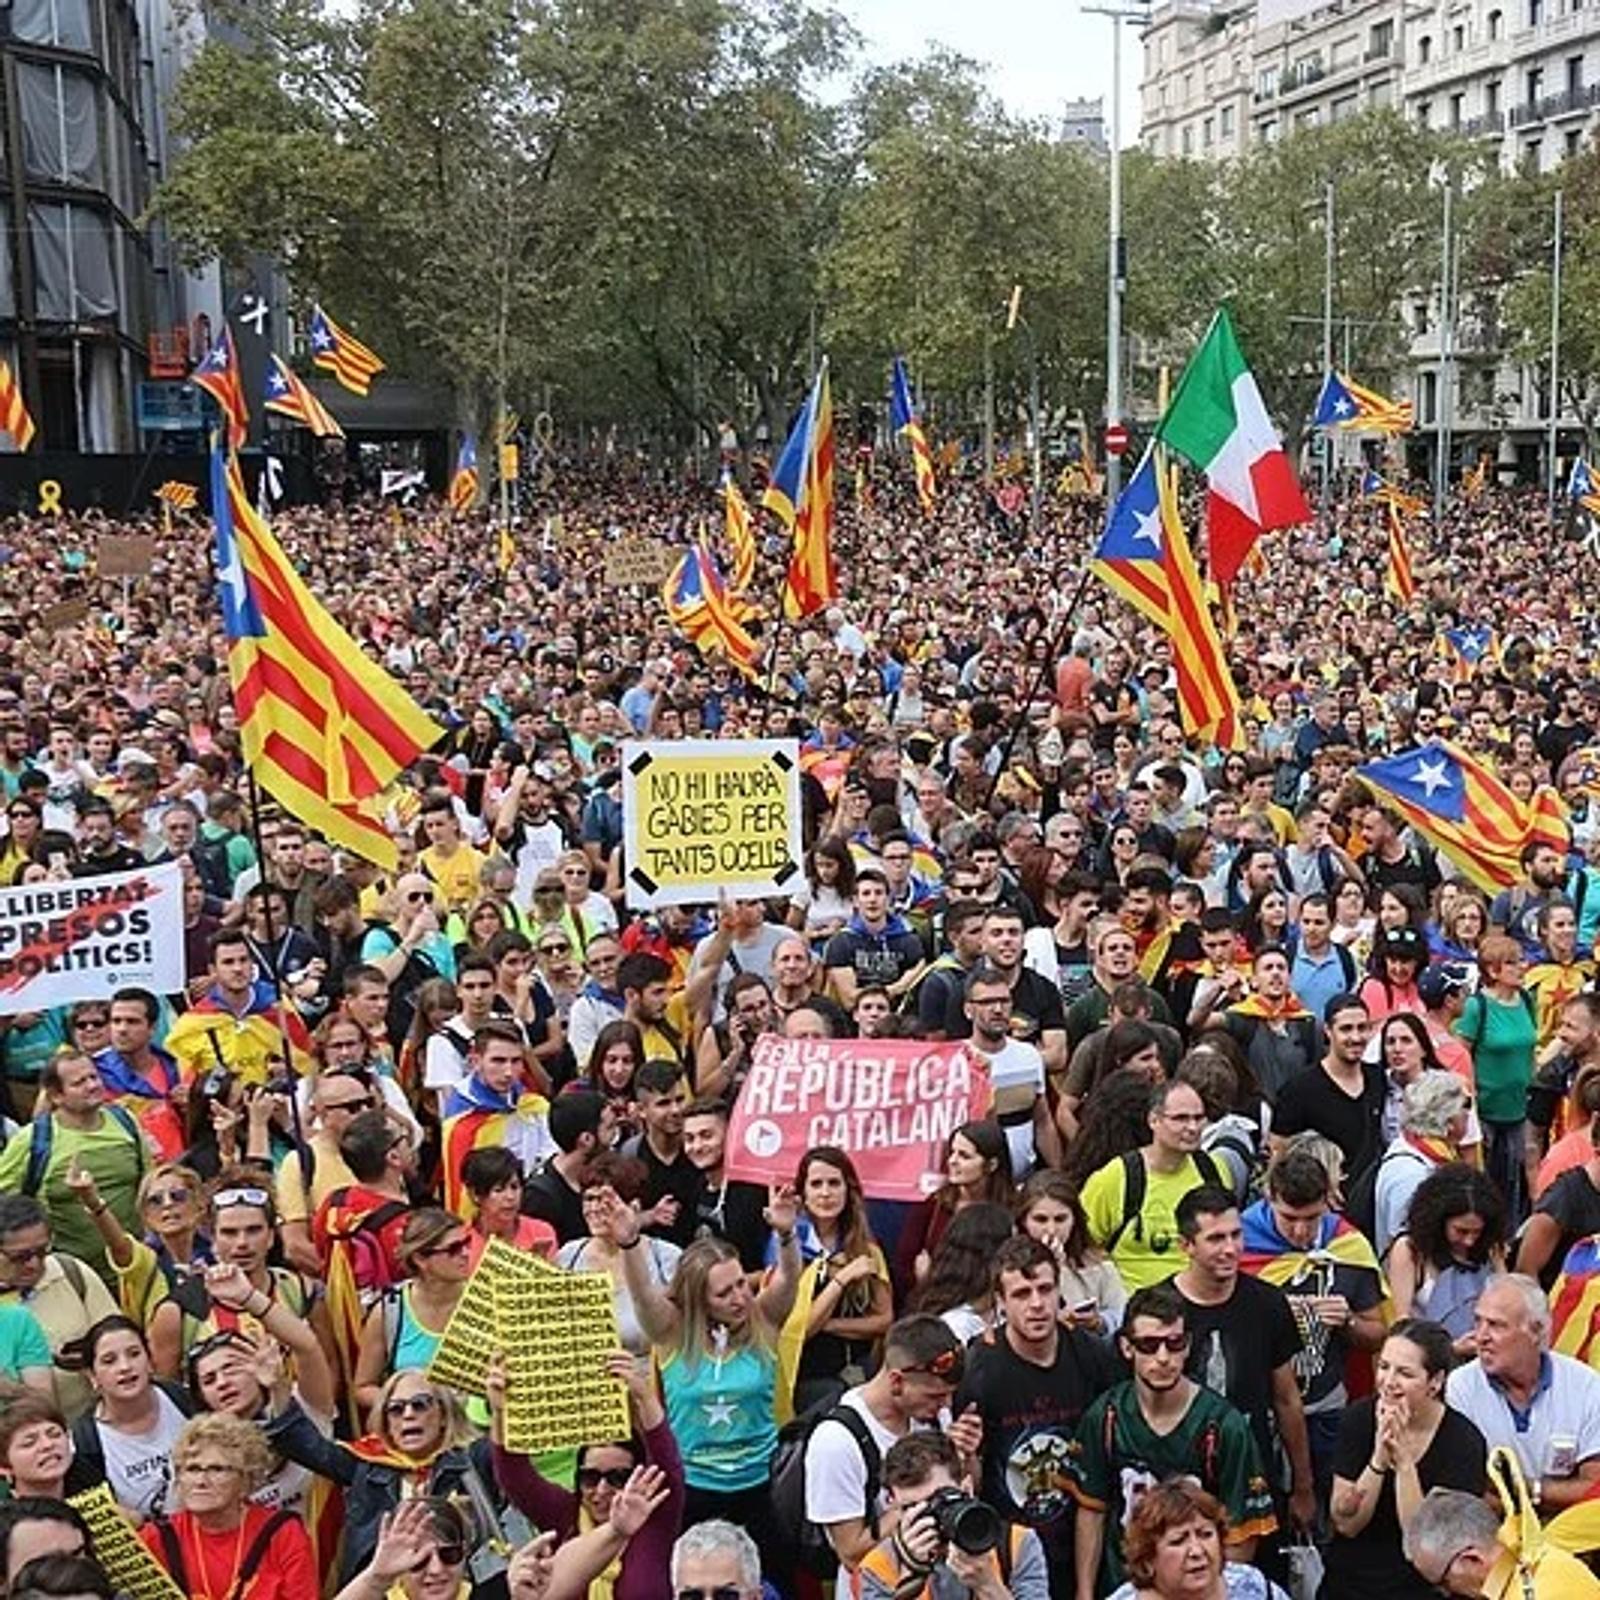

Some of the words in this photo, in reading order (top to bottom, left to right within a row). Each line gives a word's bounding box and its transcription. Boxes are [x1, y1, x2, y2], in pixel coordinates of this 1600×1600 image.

[651, 771, 680, 801] NO
[686, 772, 706, 799] HI
[648, 801, 731, 839] GÀBIES
[741, 802, 787, 833] PER
[646, 843, 715, 878] TANTS
[720, 838, 790, 871] OCELLS
[0, 909, 150, 949] PRESOS
[744, 1050, 971, 1115] REPÚBLICA
[807, 1096, 969, 1151] CATALANA
